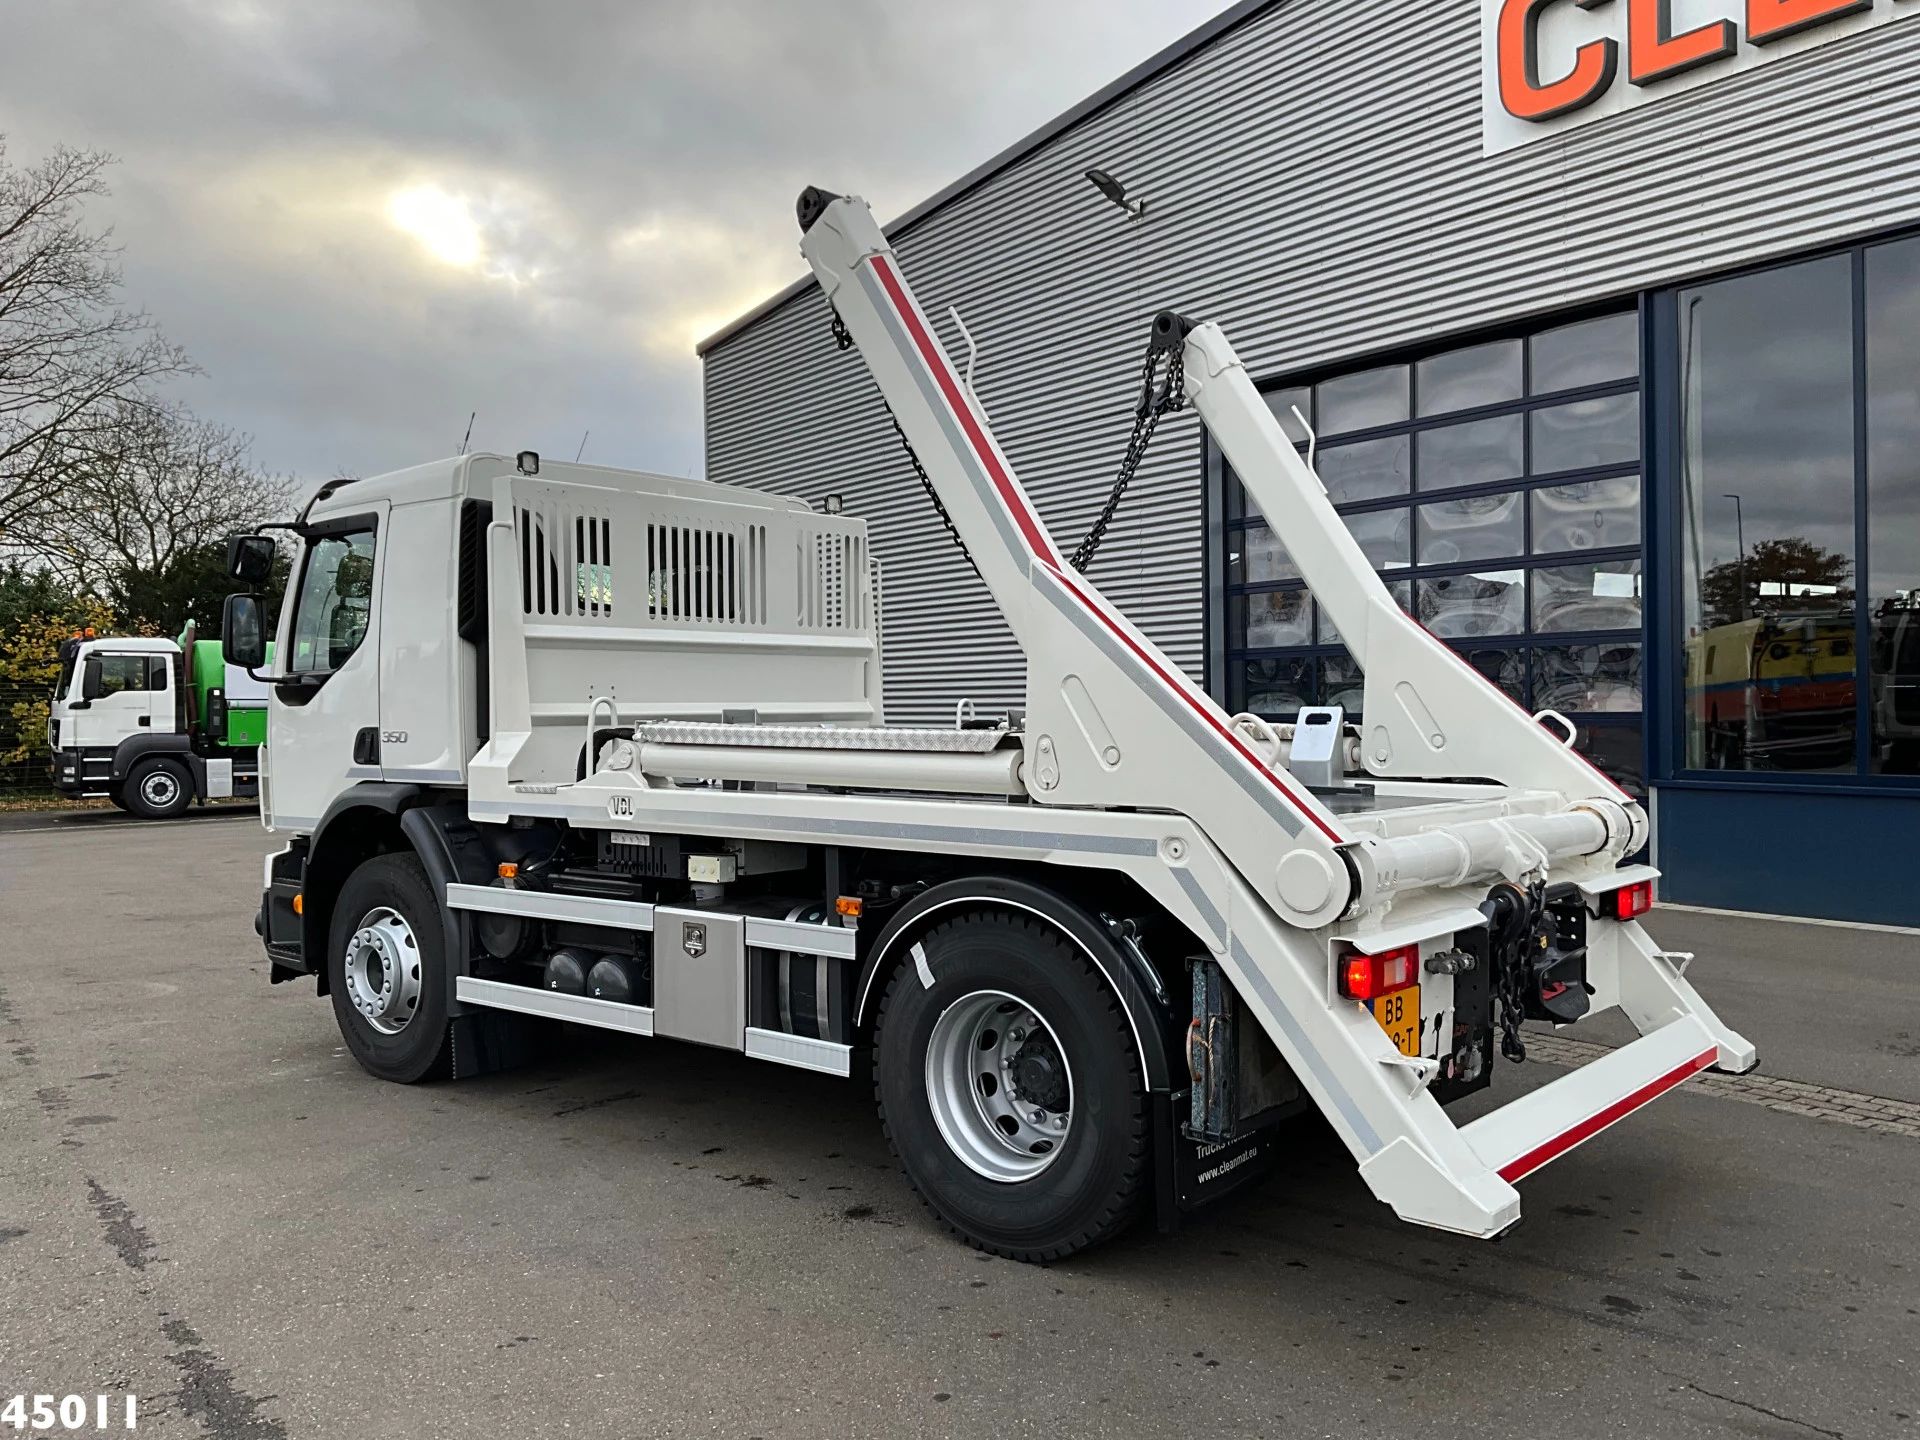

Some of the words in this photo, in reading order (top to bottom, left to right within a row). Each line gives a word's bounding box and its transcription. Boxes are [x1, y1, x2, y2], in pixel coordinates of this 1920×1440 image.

[1498, 0, 1874, 122] CL
[382, 731, 408, 743] 350
[612, 797, 633, 816] VDL
[1385, 995, 1403, 1025] BB
[1389, 1026, 1414, 1053] 8-T
[1198, 1146, 1257, 1184] www.cleanmat.eu
